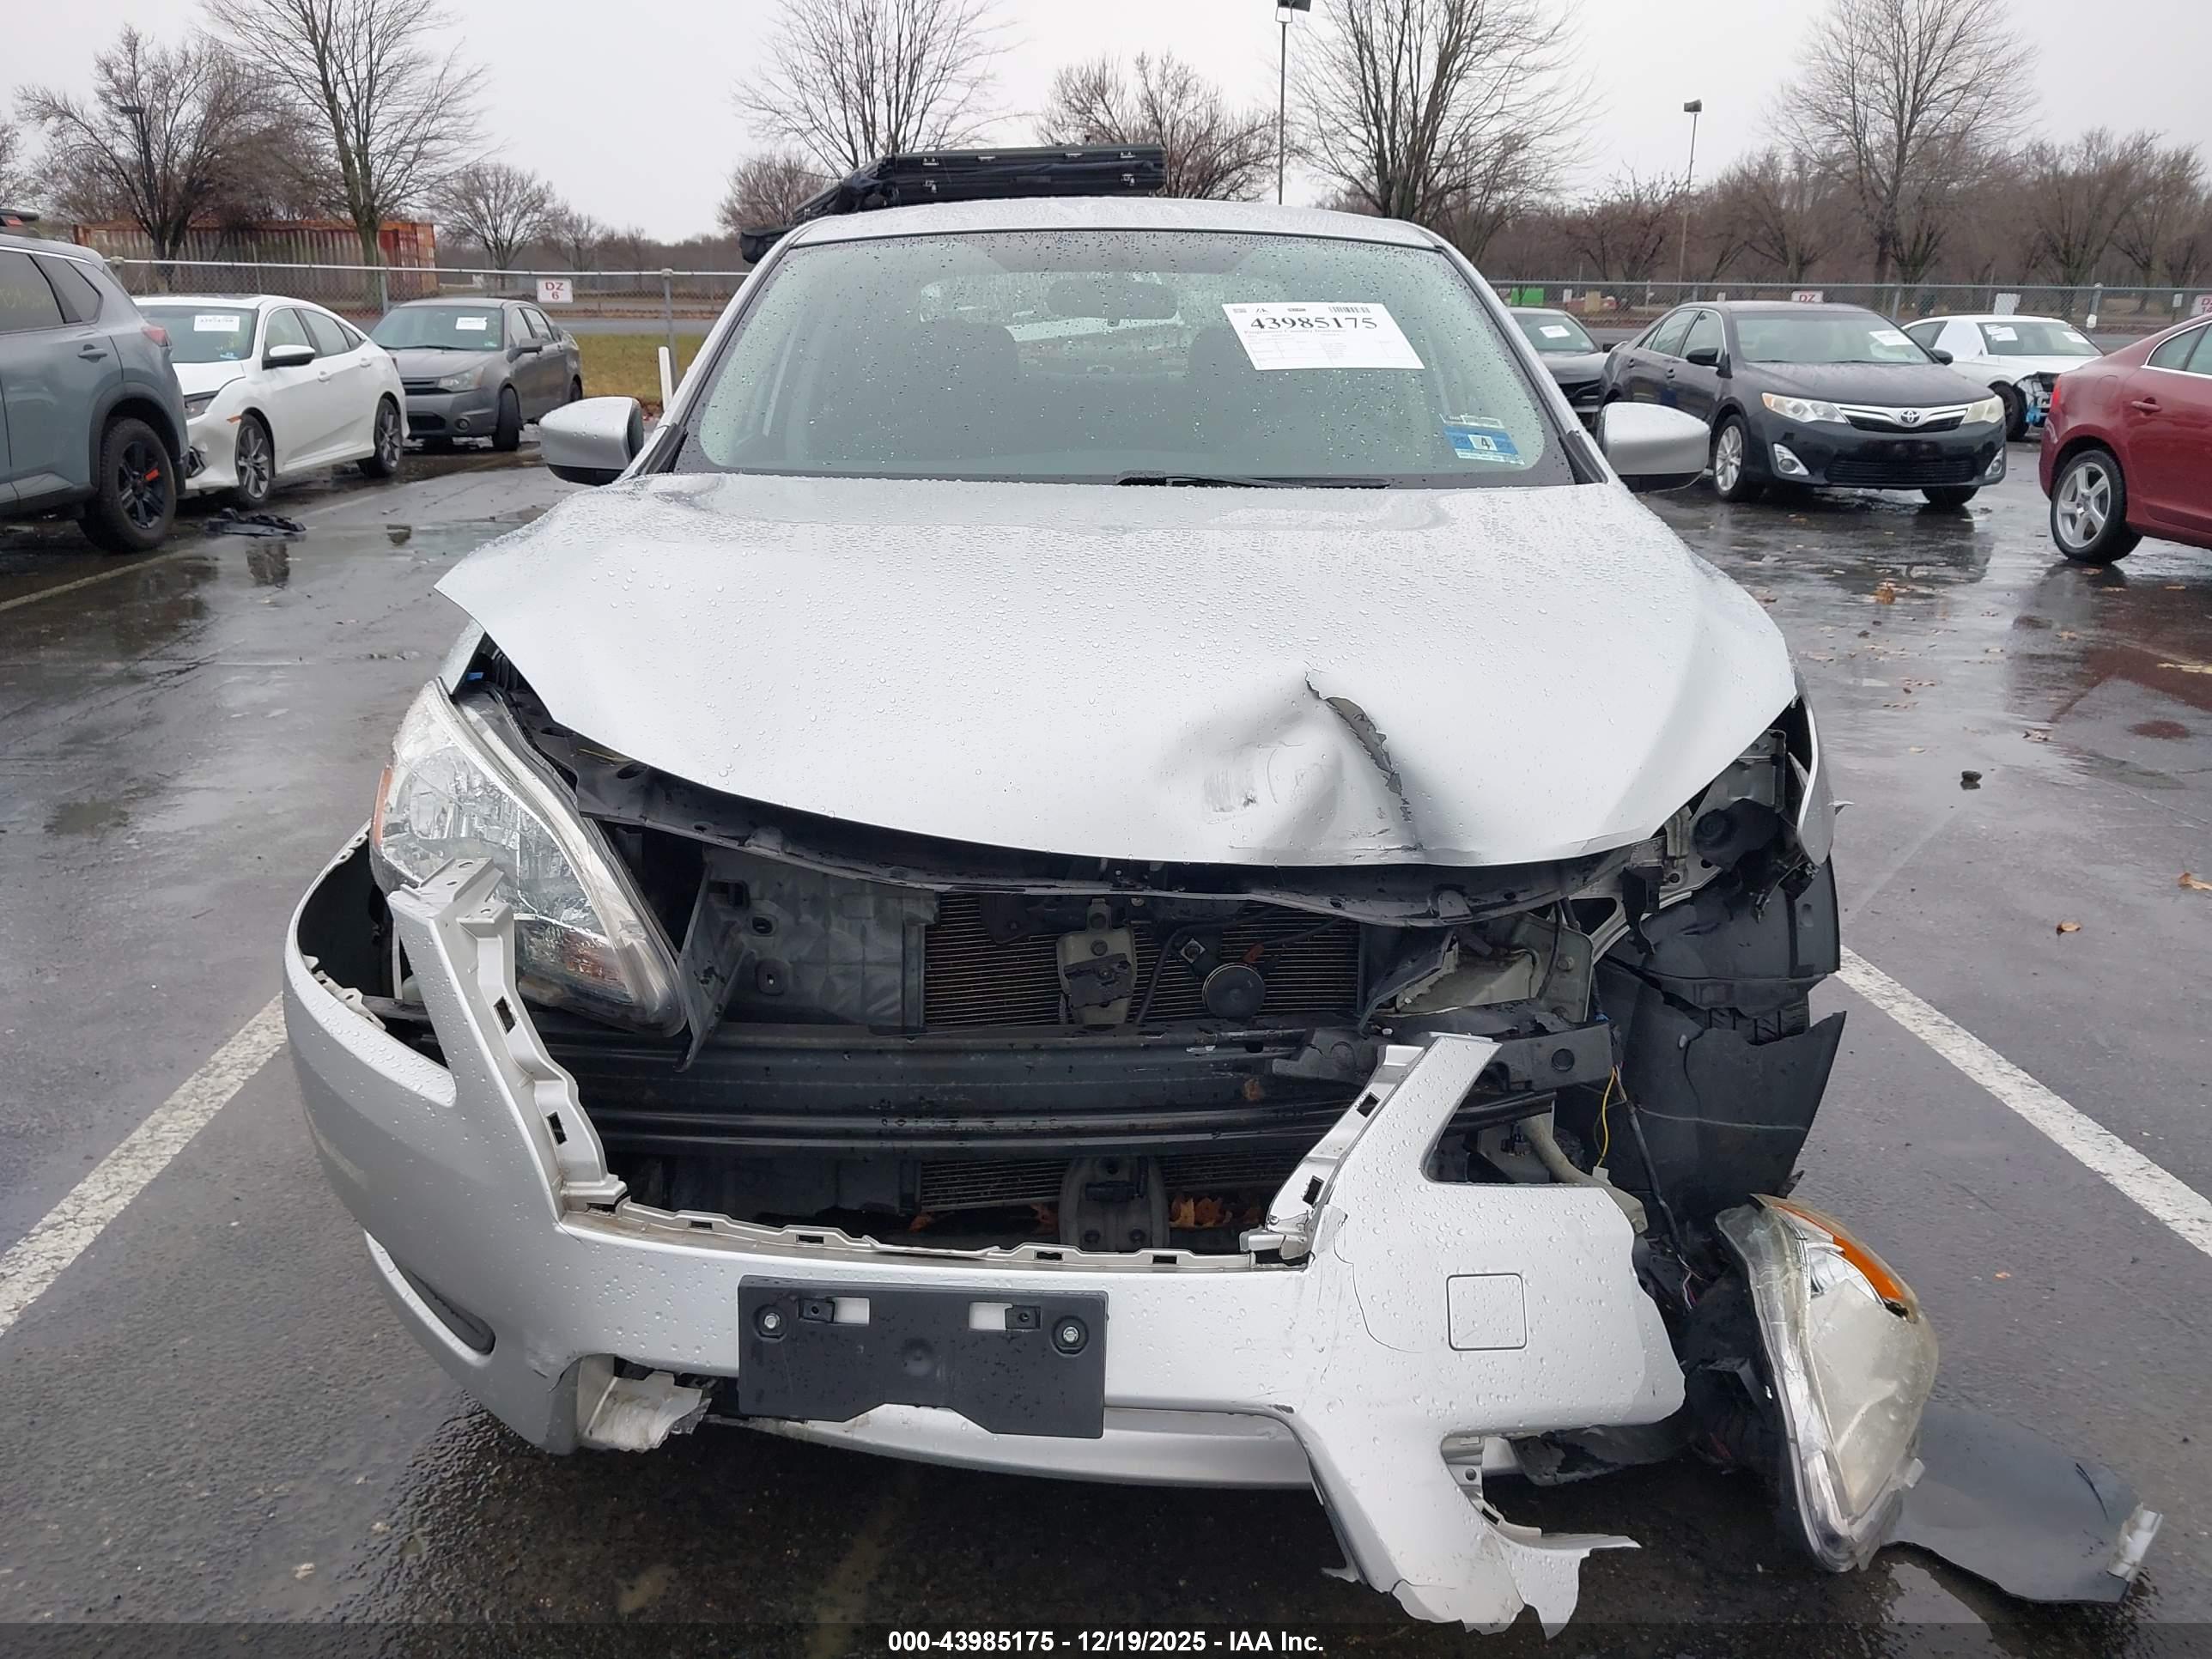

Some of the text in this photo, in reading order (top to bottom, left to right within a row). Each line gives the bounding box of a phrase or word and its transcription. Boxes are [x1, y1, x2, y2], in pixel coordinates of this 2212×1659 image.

[545, 282, 563, 291] DZ
[551, 291, 560, 300] 6
[1799, 294, 1815, 302] DZ
[2201, 297, 2212, 306] D
[1250, 317, 1378, 329] 43985175
[1480, 437, 1491, 450] 4
